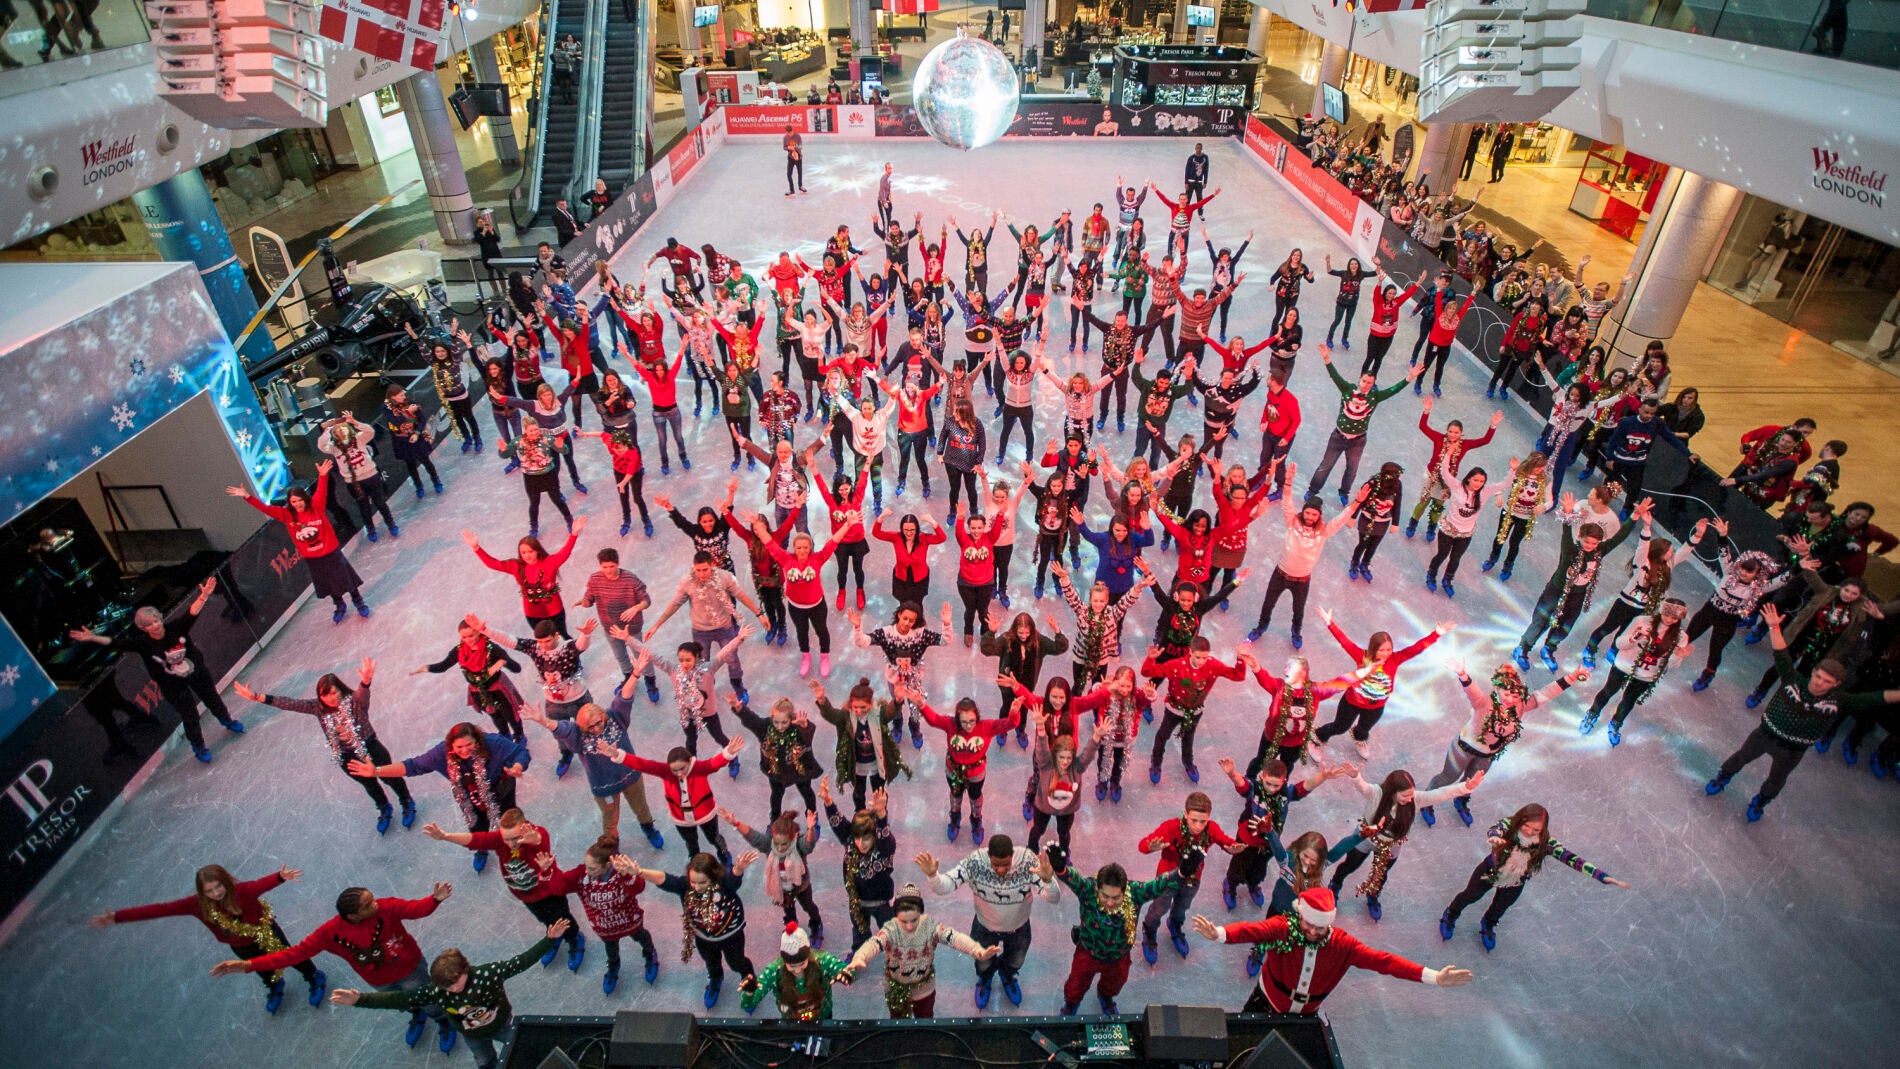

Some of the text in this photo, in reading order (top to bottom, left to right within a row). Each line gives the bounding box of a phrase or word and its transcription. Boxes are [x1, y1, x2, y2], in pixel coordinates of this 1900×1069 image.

[758, 113, 790, 123] Ascend
[790, 113, 803, 123] P6
[80, 134, 137, 170] Westfield
[83, 156, 134, 186] LONDON
[1810, 146, 1889, 192] Westfield
[1813, 175, 1883, 208] LONDON
[8, 785, 92, 864] TRESOR
[46, 817, 76, 850] PARIS
[590, 888, 619, 901] MERRY
